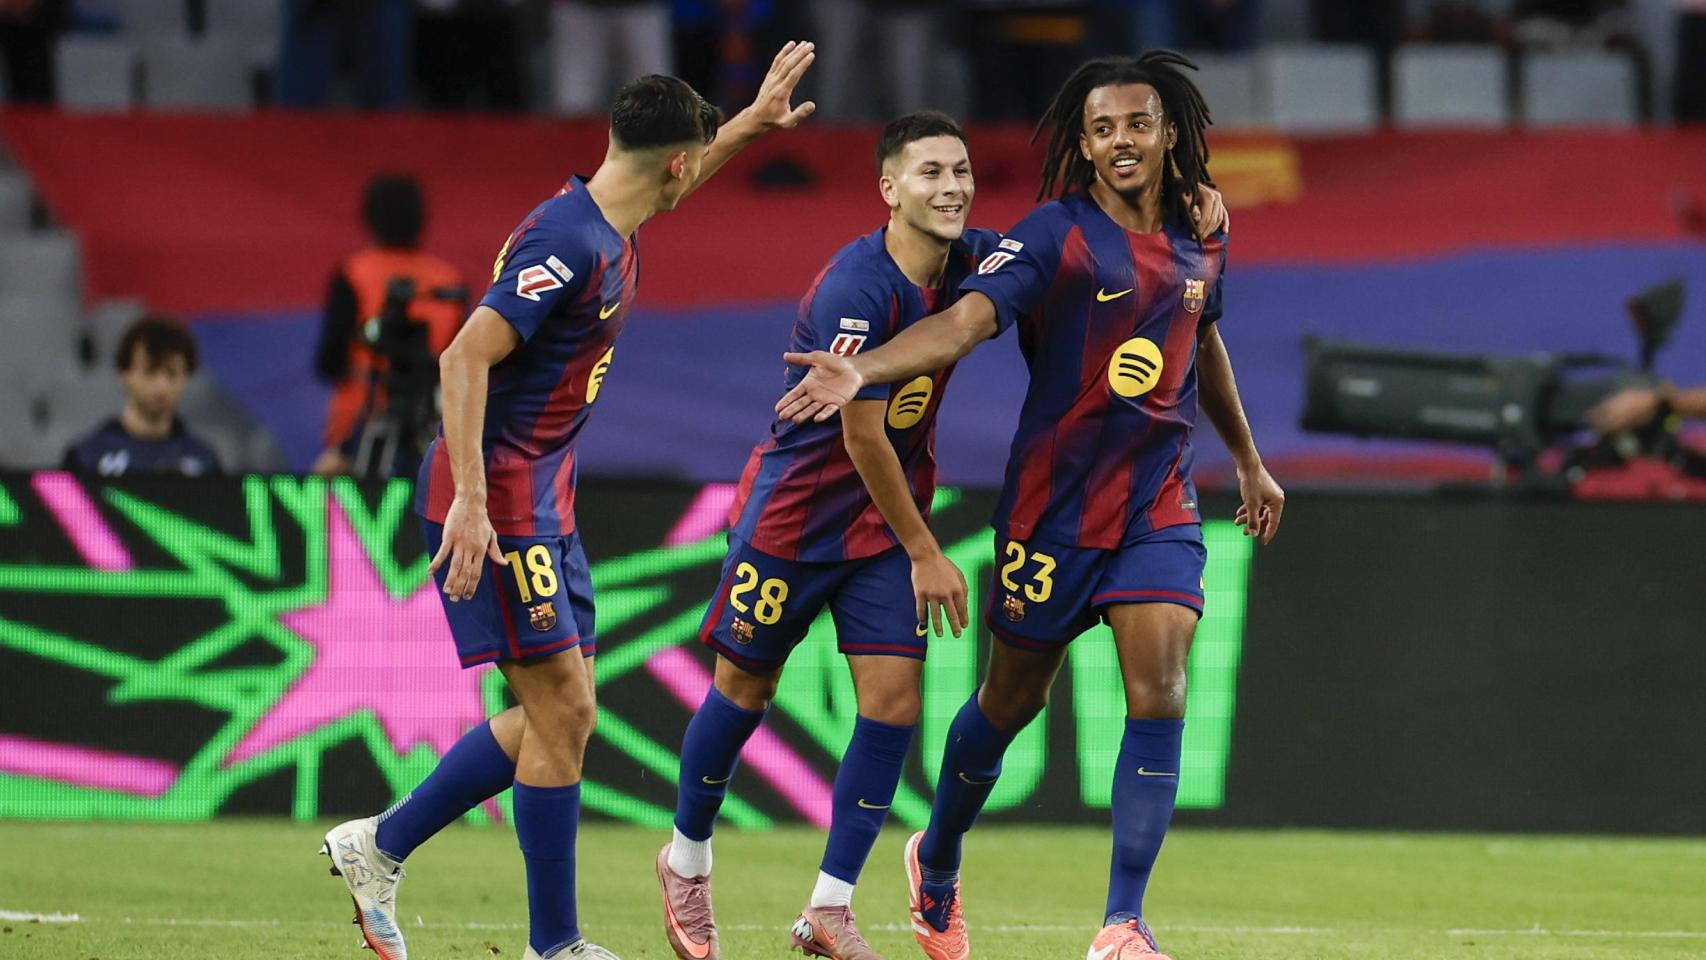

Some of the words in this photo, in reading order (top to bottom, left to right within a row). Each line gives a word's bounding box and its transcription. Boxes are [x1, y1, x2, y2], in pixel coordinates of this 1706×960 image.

[505, 544, 558, 603] 18
[730, 561, 789, 625] 28
[1001, 540, 1057, 603] 23
